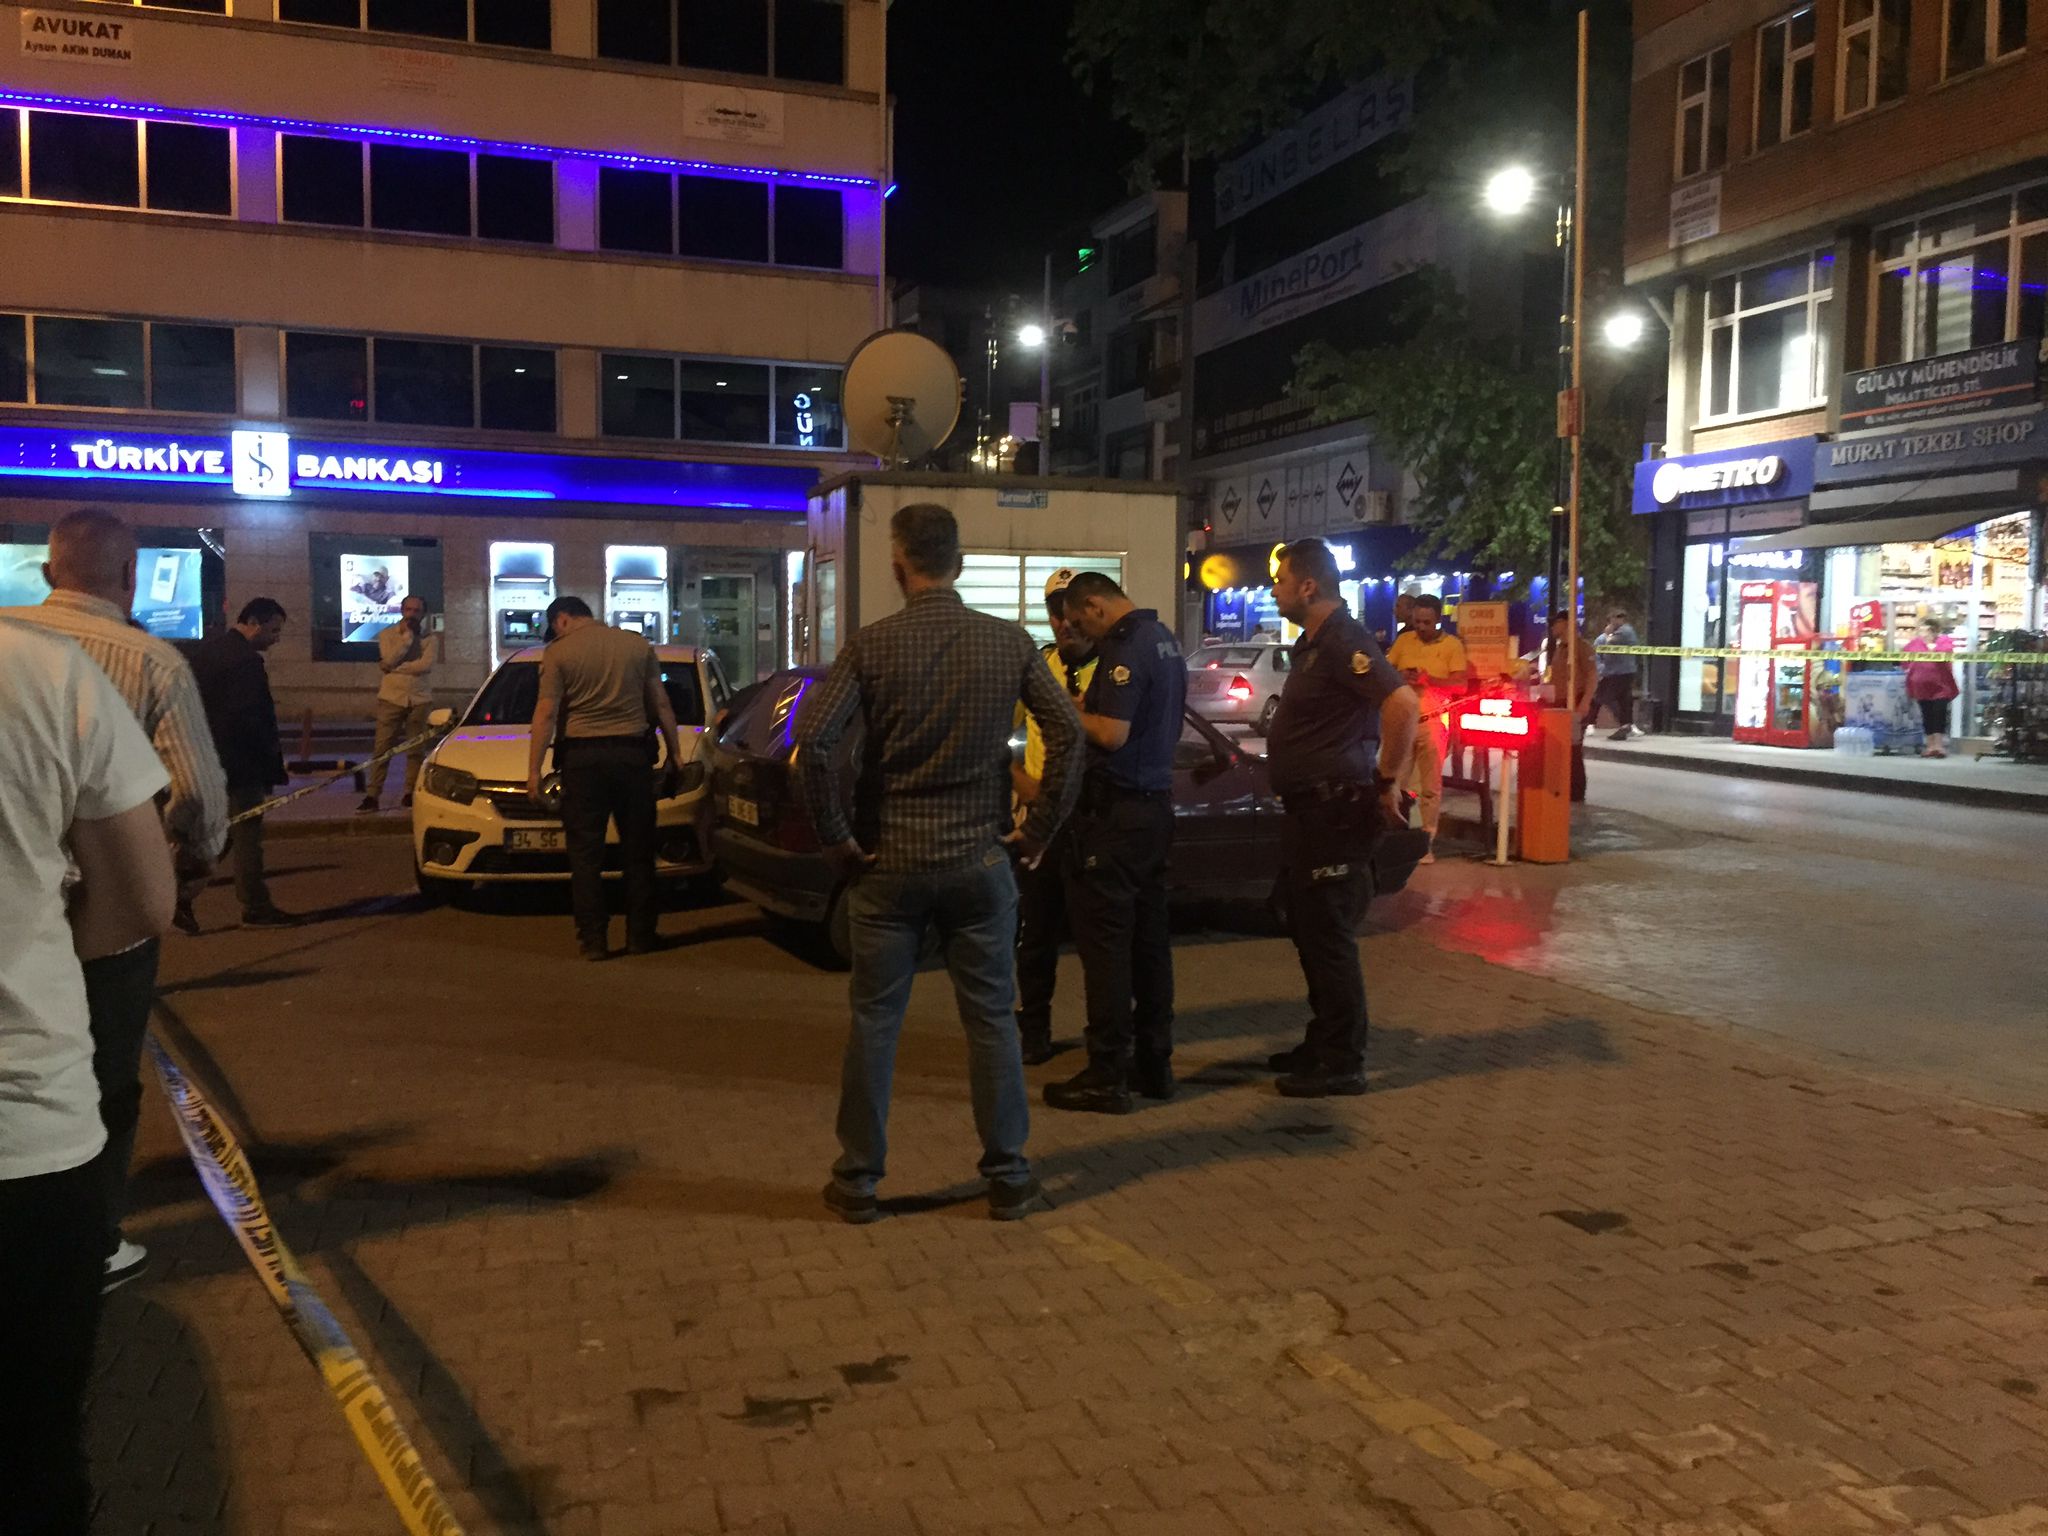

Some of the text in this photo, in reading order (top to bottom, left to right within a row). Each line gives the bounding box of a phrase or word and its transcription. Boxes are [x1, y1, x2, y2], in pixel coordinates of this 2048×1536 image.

[32, 16, 123, 40] AVUKAT
[25, 40, 57, 53] Aysun
[92, 47, 131, 59] DUMAN
[1241, 236, 1364, 317] MinePort
[1855, 346, 2019, 394] GÜLAY MÜHENDİSLİK
[71, 439, 225, 474] TÜRKİYE
[297, 454, 442, 483] BANKASI
[1831, 420, 2035, 466] MURAT TEKEL SHOP
[1679, 455, 1781, 494] METRO
[514, 832, 531, 847] 34
